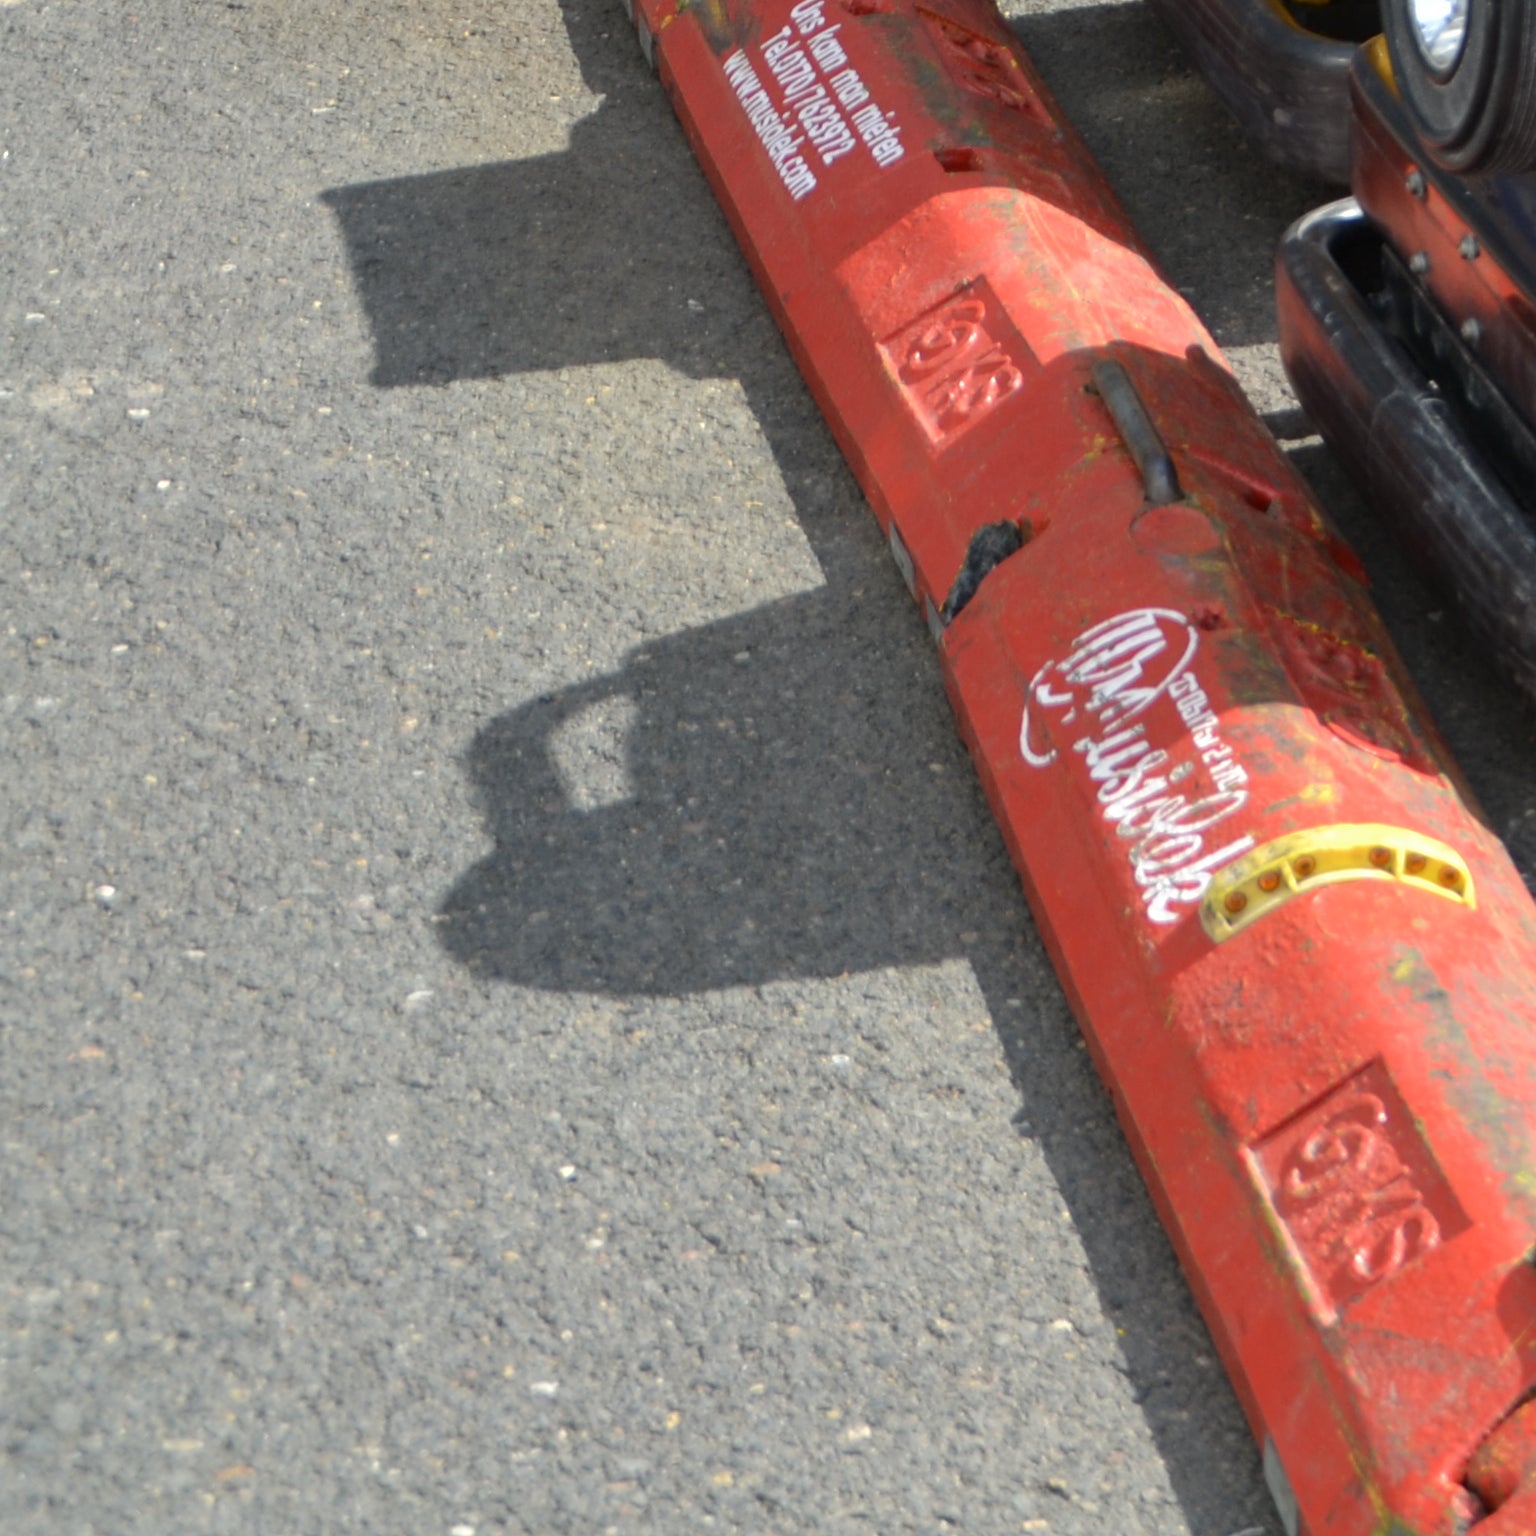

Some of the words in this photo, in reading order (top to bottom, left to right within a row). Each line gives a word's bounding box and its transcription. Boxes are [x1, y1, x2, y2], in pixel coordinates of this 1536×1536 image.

[723, 48, 817, 201] www.musialek.com
[807, 23, 848, 73] kann
[829, 69, 870, 112] man
[851, 103, 904, 168] mieten
